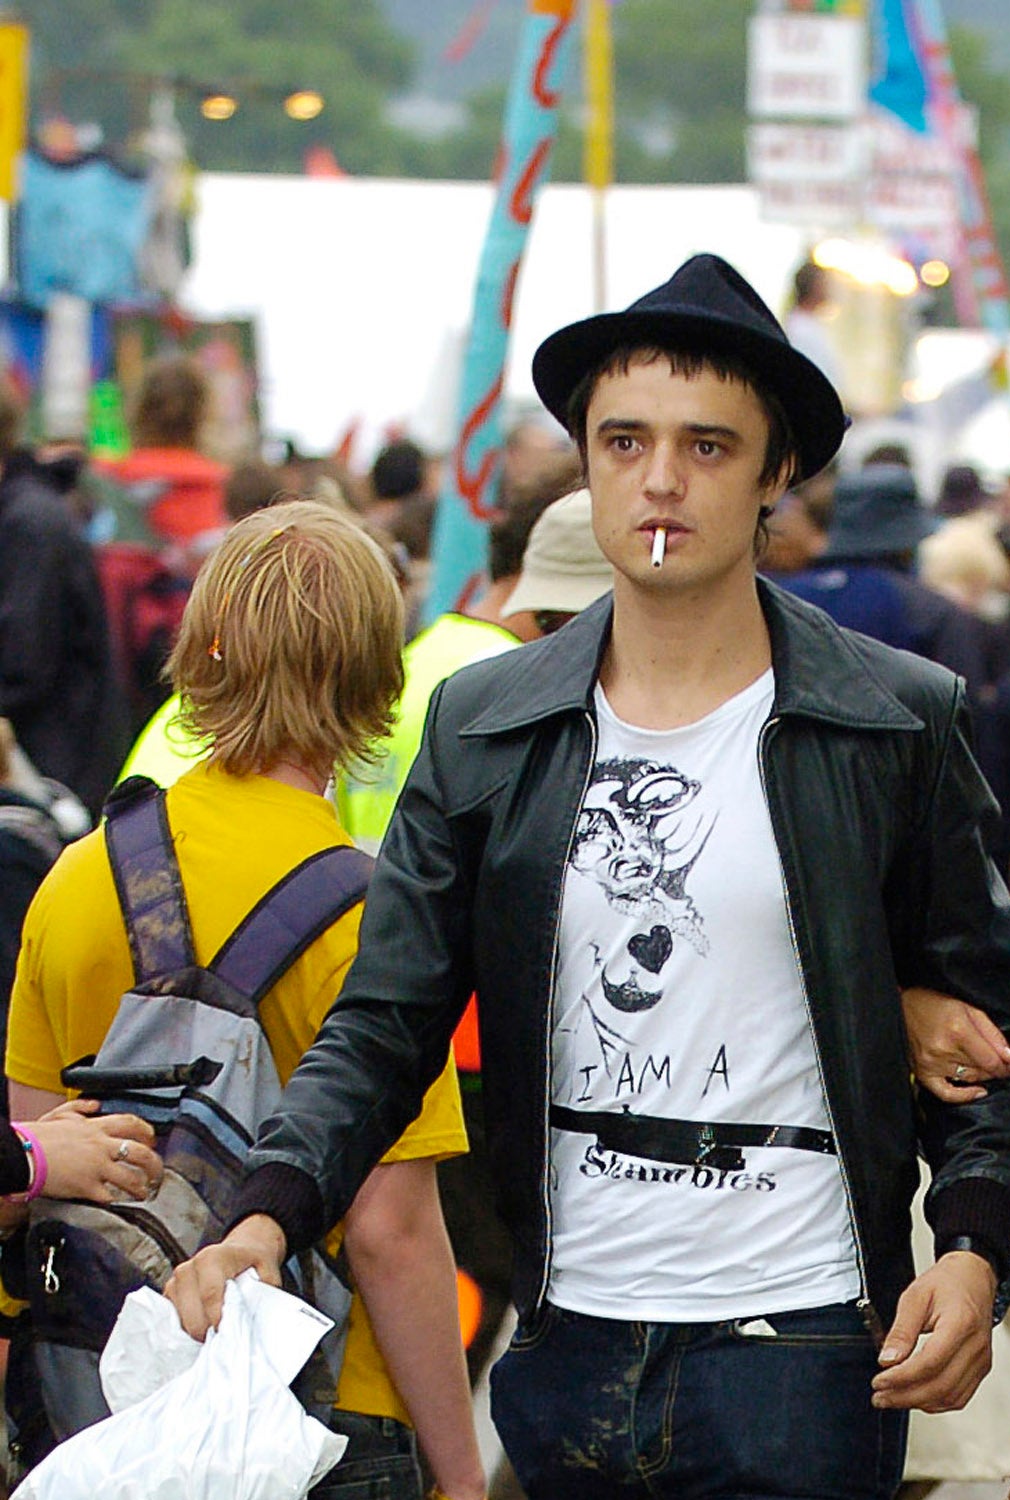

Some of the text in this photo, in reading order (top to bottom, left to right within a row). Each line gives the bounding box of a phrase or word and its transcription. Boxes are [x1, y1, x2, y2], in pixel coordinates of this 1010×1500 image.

[577, 1043, 730, 1102] I AM A
